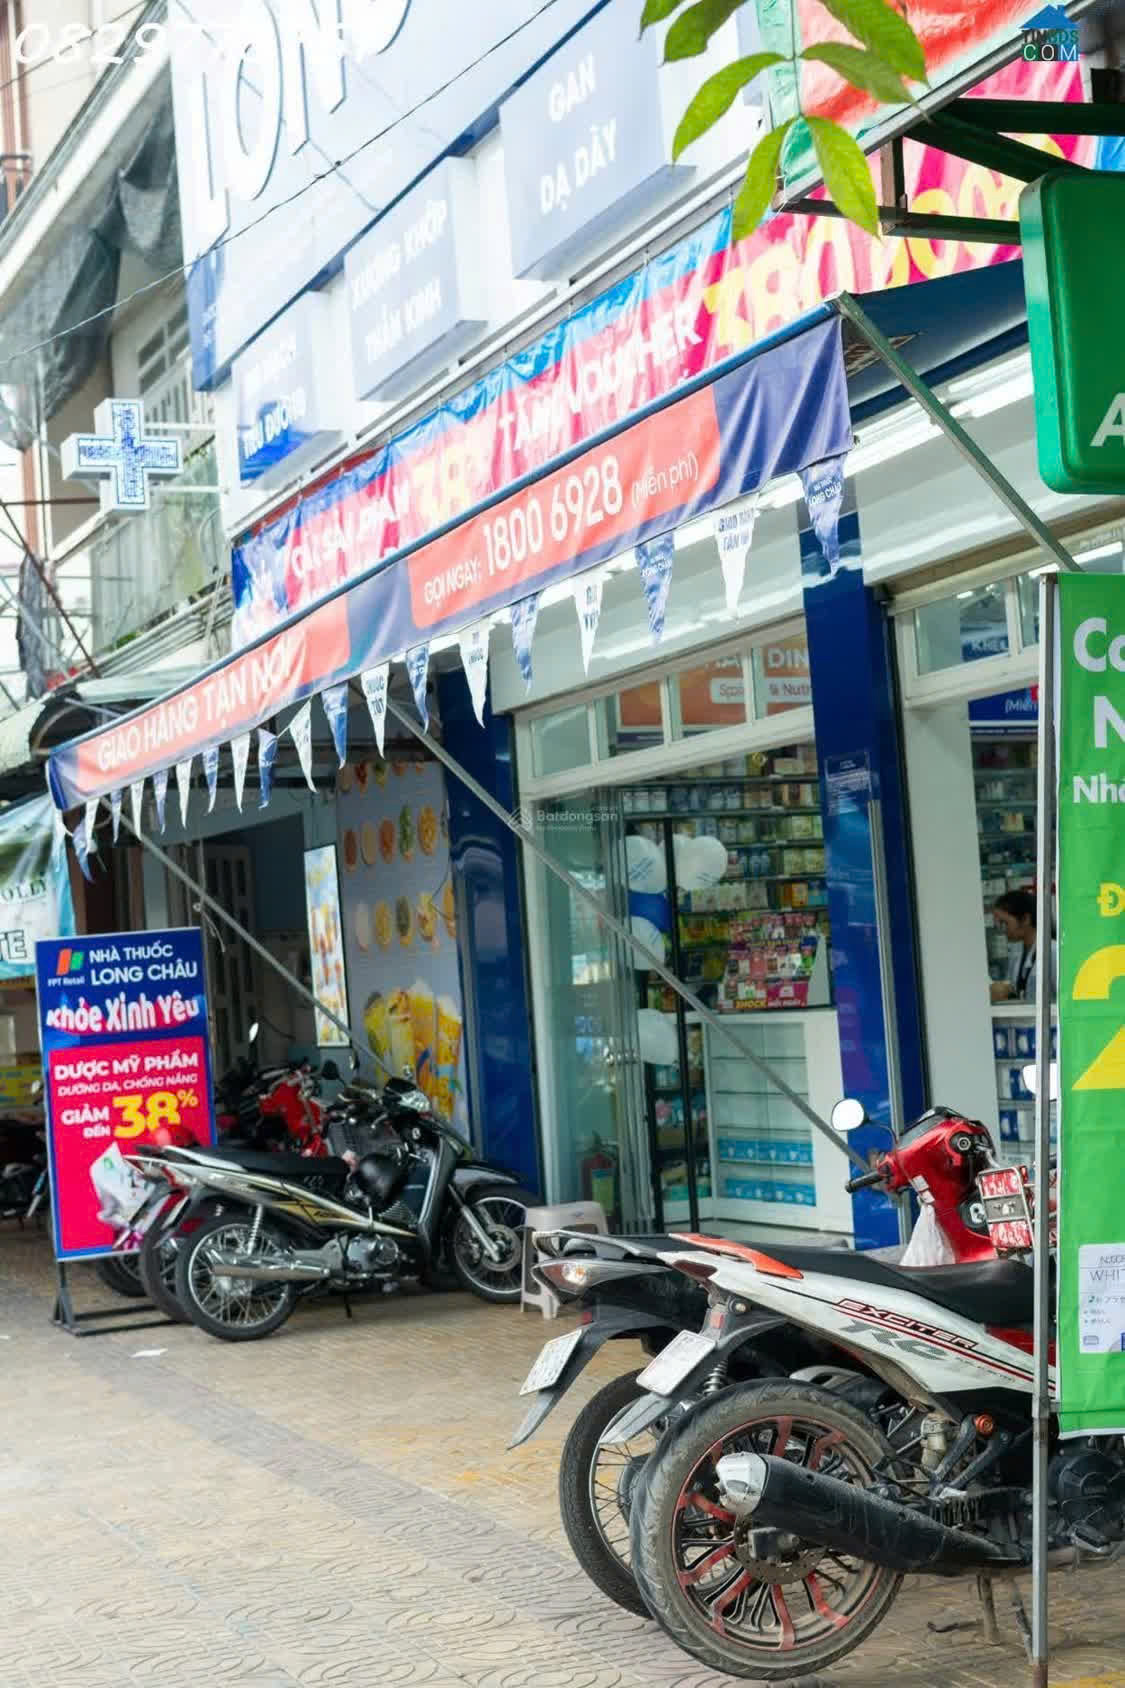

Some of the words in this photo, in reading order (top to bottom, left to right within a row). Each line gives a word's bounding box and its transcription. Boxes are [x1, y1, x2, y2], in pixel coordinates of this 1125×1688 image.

[483, 498, 544, 577] 1800
[550, 454, 624, 543] 6928
[89, 945, 121, 964] NHÀ
[123, 940, 174, 961] THUỐC
[90, 966, 144, 986] LONG
[147, 958, 197, 981] CHÂU
[105, 991, 157, 1032] Xinh
[157, 990, 200, 1025] Yêu
[54, 1060, 110, 1081] DƯỢC
[112, 1053, 141, 1075] MỸ
[61, 1102, 110, 1126] GIẢM
[838, 1299, 978, 1351] EXCITER
